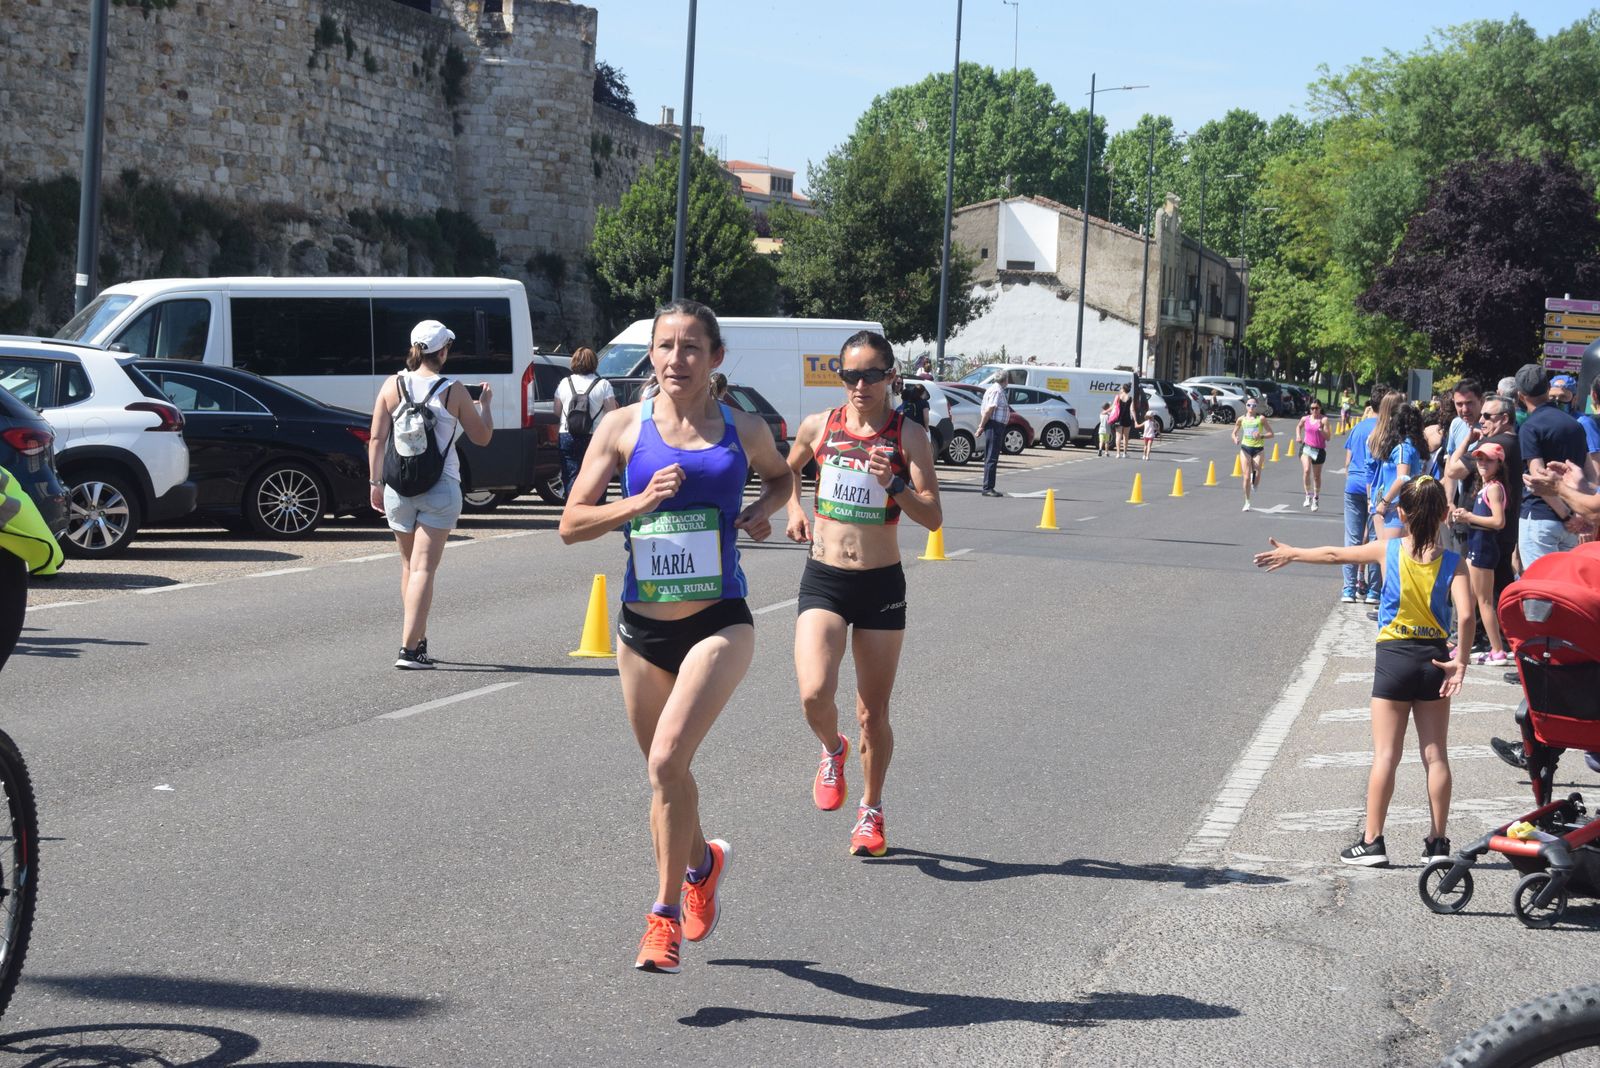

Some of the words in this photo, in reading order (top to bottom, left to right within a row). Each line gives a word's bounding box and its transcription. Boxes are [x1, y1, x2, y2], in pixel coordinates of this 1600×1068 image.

[1089, 380, 1121, 392] Hertz
[824, 454, 870, 472] KEN
[832, 483, 870, 504] MARTA
[855, 510, 881, 519] RURAL
[654, 523, 675, 532] CAJA
[677, 521, 707, 531] RURAL
[651, 541, 656, 552] 8
[651, 548, 695, 575] MARÍA
[657, 585, 681, 595] CAJA
[683, 582, 717, 593] RURAL
